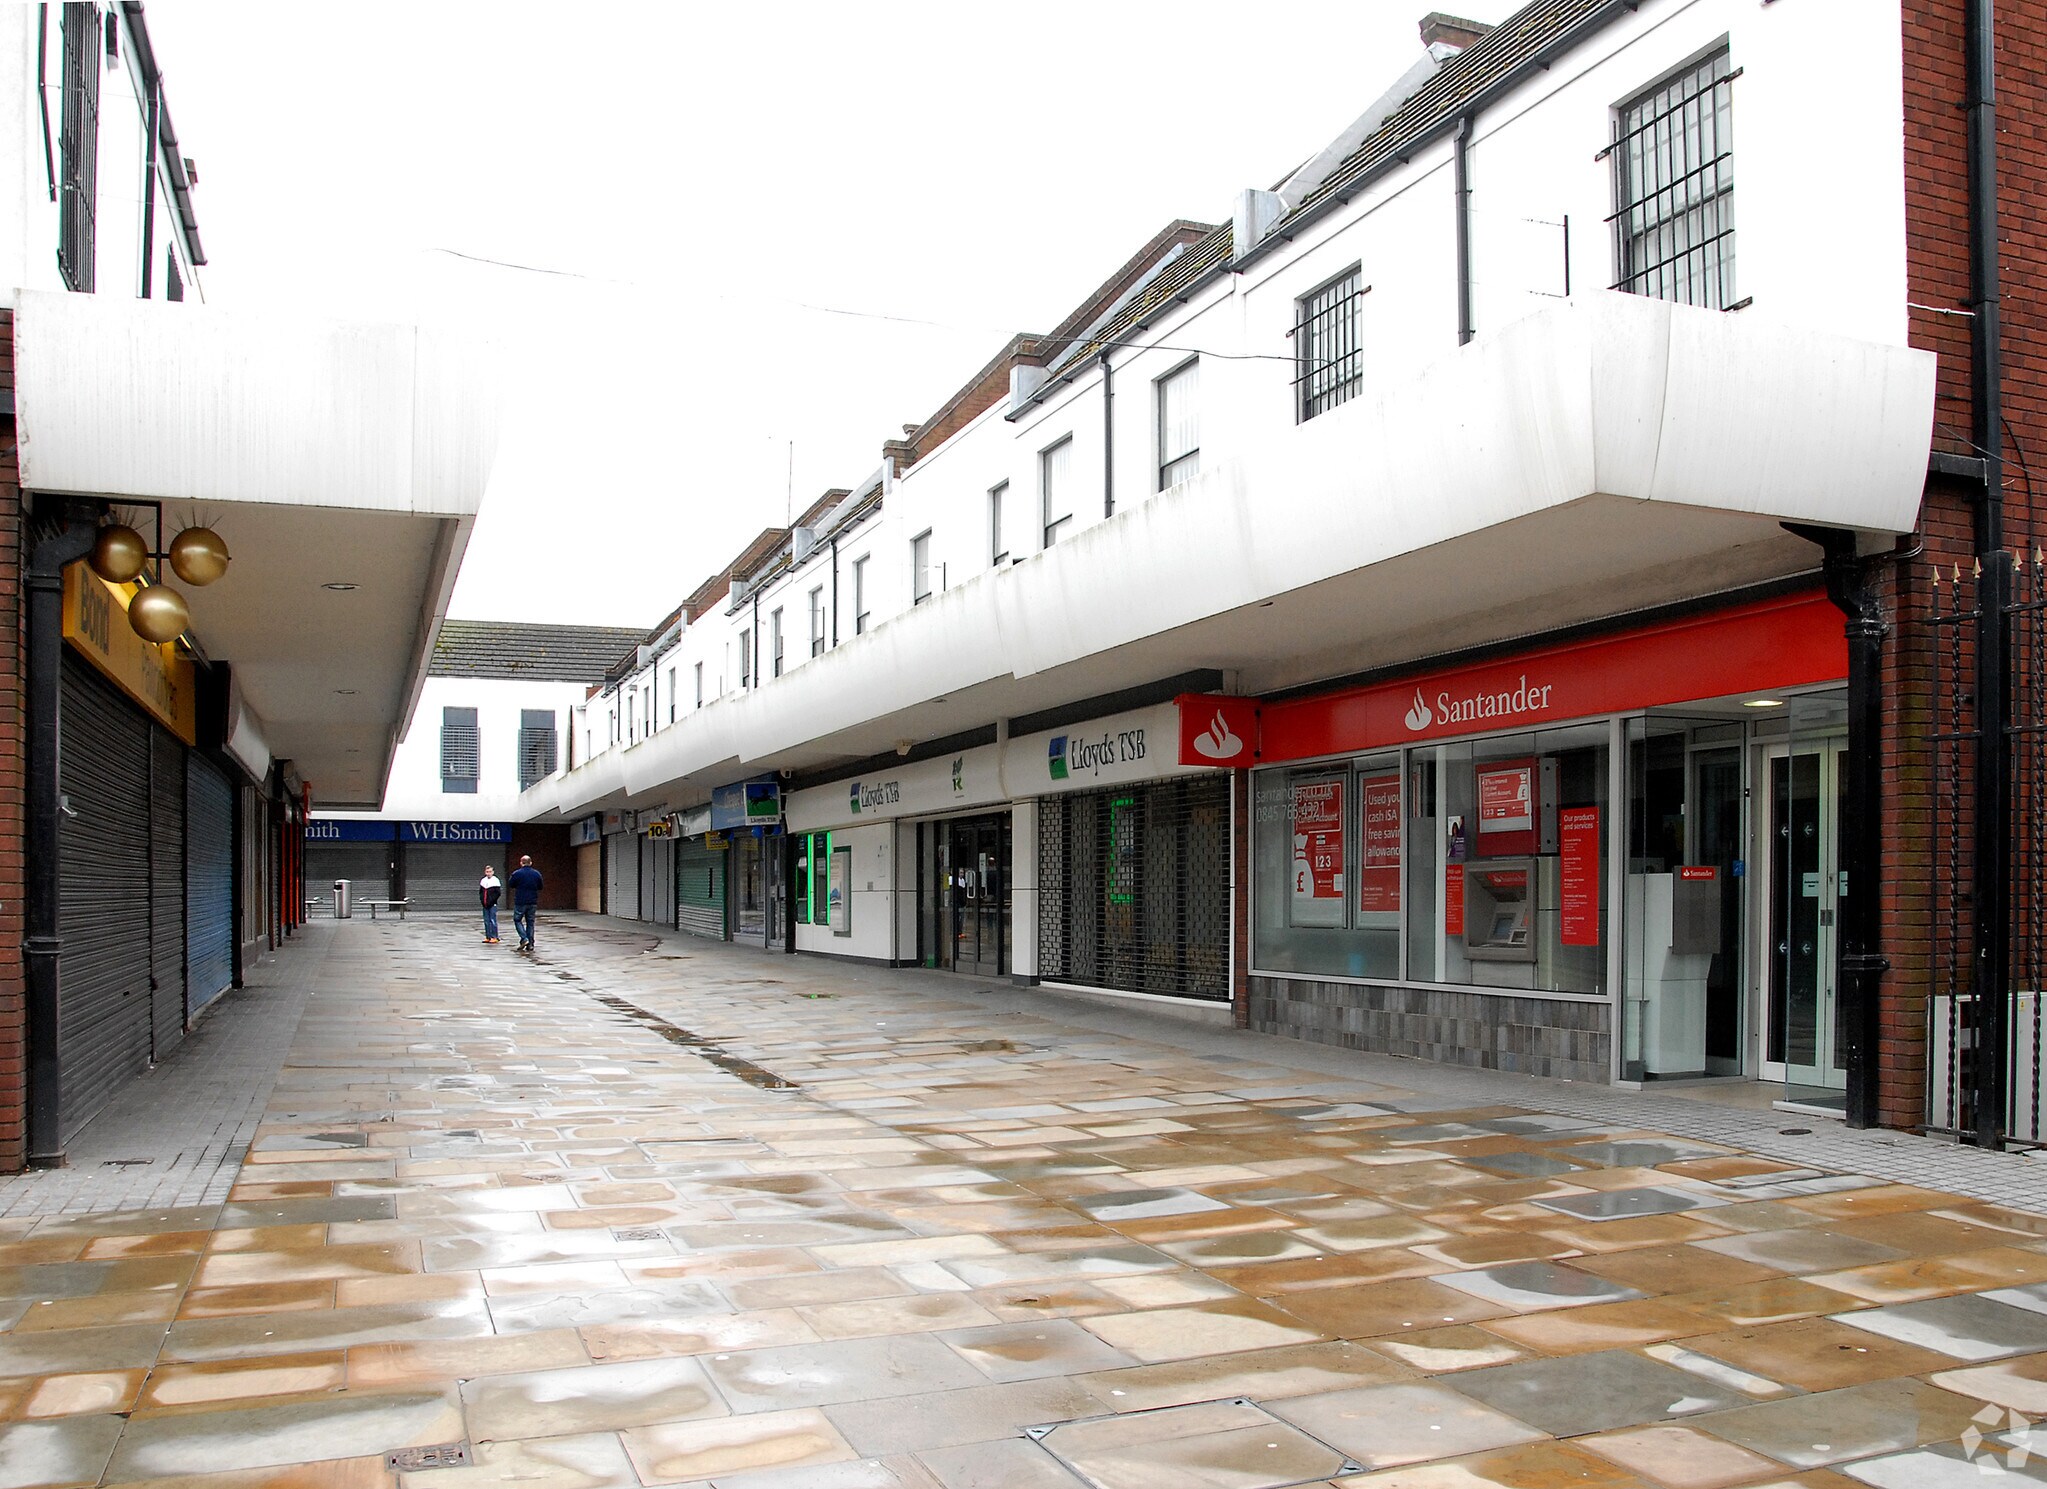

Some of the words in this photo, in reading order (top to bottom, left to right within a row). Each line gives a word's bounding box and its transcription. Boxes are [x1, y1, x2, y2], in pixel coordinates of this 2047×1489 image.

[80, 565, 109, 656] Bond
[1437, 675, 1552, 725] Santander
[1071, 739, 1114, 777] Lloyds
[1118, 729, 1146, 763] TSB
[860, 784, 884, 812] Lloyds
[885, 780, 900, 805] TSB
[1368, 792, 1386, 805] Used
[1256, 805, 1278, 823] 0845
[1301, 801, 1325, 820] 4321
[1368, 810, 1384, 822] cash
[1385, 809, 1397, 821] ISA
[1573, 814, 1595, 822] products
[411, 822, 501, 840] WHSmith
[1368, 828, 1382, 839] free
[1296, 871, 1304, 892] £
[1690, 869, 1713, 877] Santander
